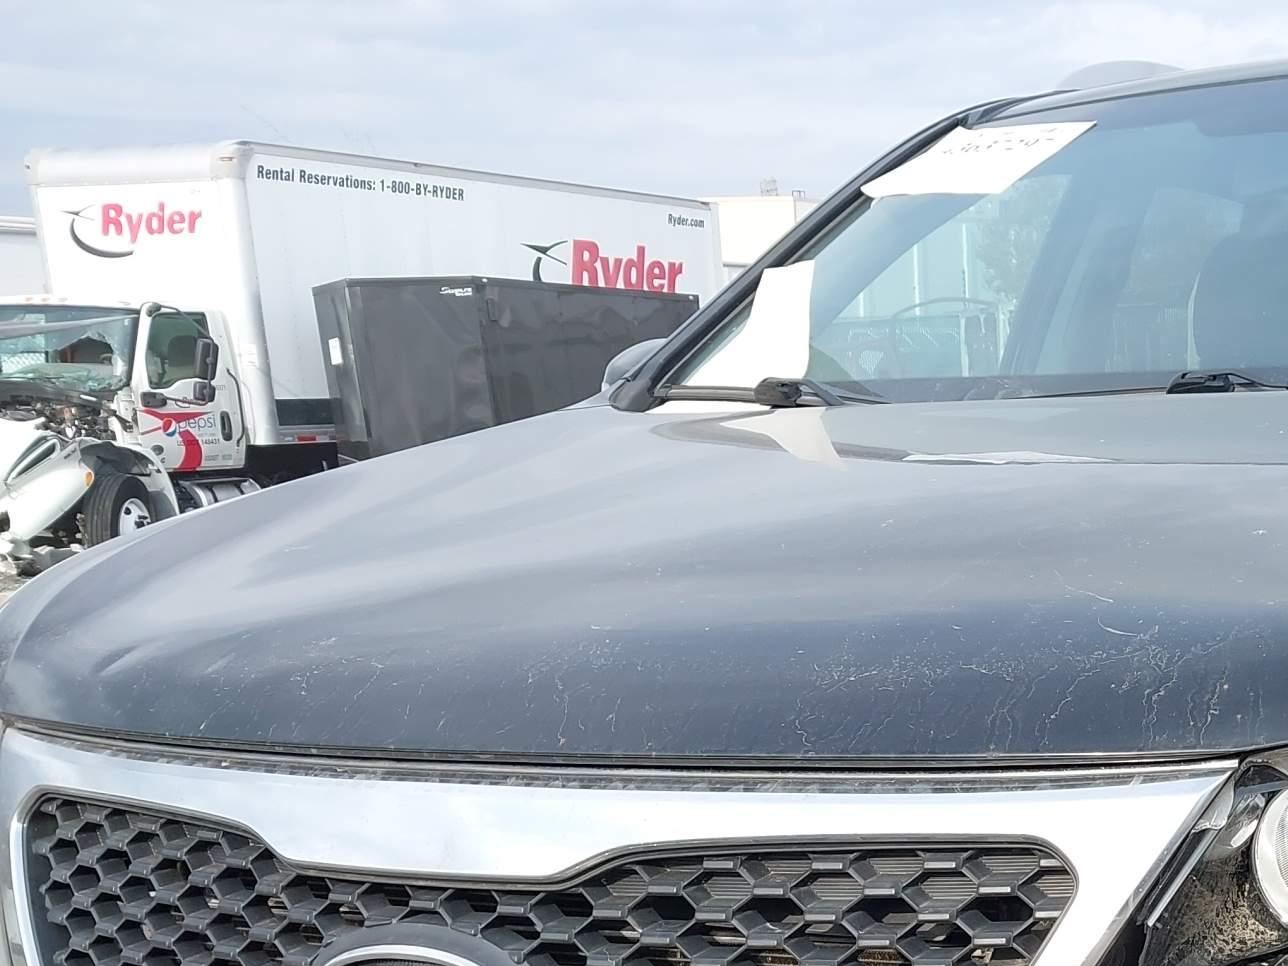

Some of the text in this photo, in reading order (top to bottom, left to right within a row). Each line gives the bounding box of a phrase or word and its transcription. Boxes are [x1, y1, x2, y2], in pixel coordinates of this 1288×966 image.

[257, 165, 464, 201] Rental Reservations: 1-800-BY-RYDER
[101, 201, 202, 244] Ryder
[668, 213, 704, 228] Ryder.com
[178, 414, 217, 432] pepsi
